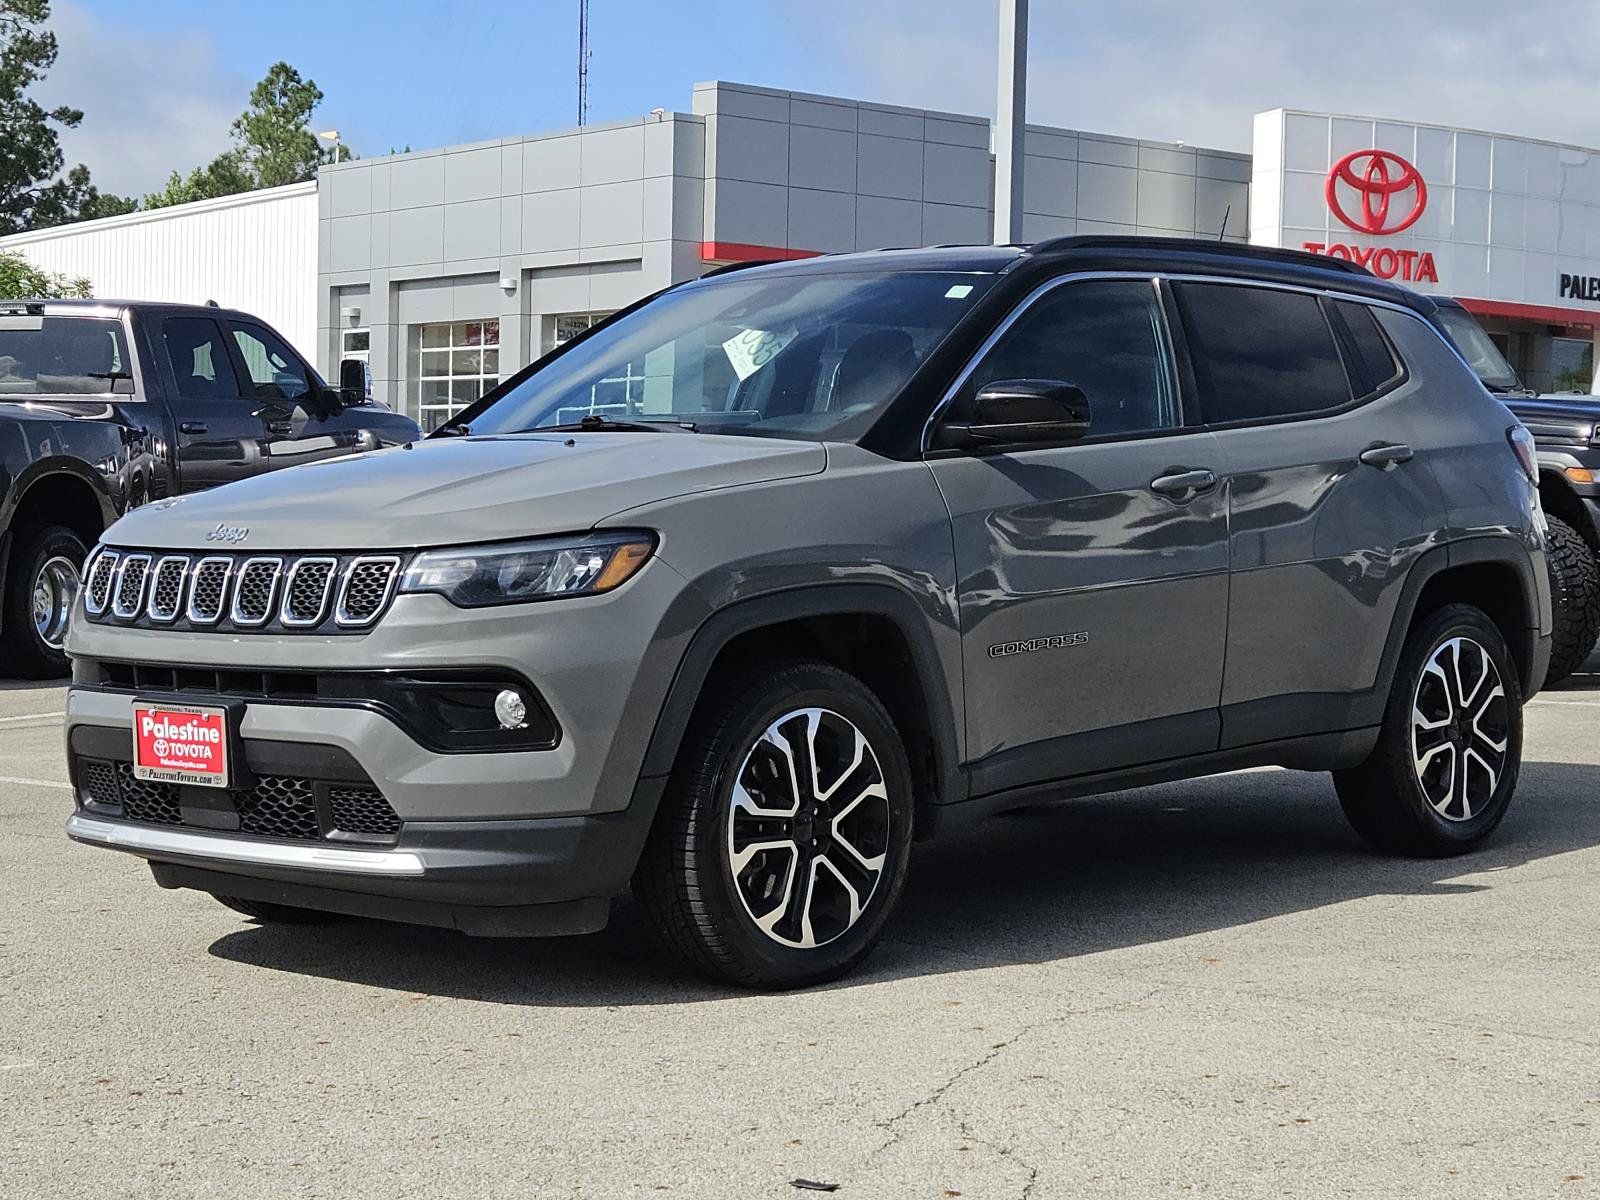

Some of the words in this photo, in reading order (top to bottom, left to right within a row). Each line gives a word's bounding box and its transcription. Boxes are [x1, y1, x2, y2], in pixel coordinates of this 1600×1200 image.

[1560, 273, 1600, 301] PALE
[205, 522, 250, 545] Jeep
[988, 631, 1089, 658] COMPASS
[142, 716, 220, 744] Palestine
[169, 742, 213, 759] TOYOTA
